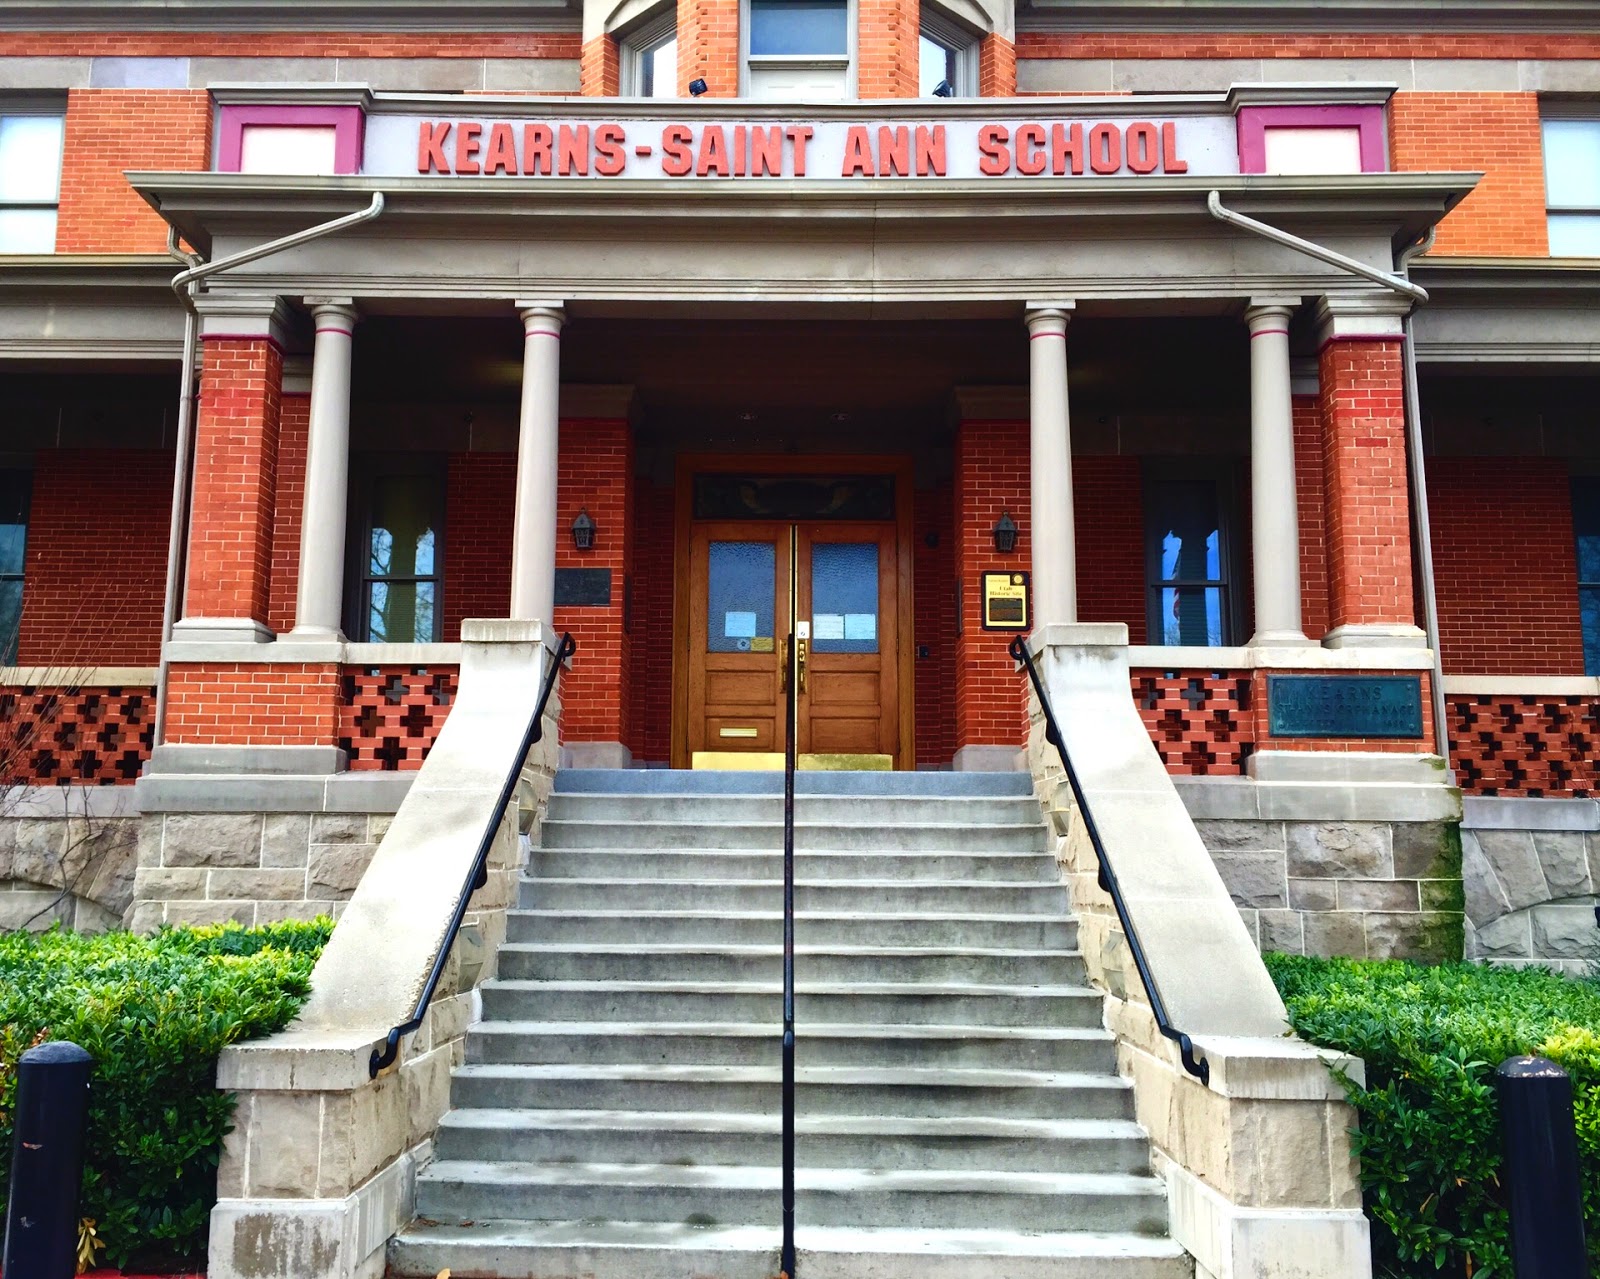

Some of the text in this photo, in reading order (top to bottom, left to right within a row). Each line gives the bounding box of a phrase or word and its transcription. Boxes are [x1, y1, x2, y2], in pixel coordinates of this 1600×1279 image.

[418, 121, 1188, 177] KEARNS-SAINT ANN SCHOOL
[1309, 685, 1382, 700] KEARNS
